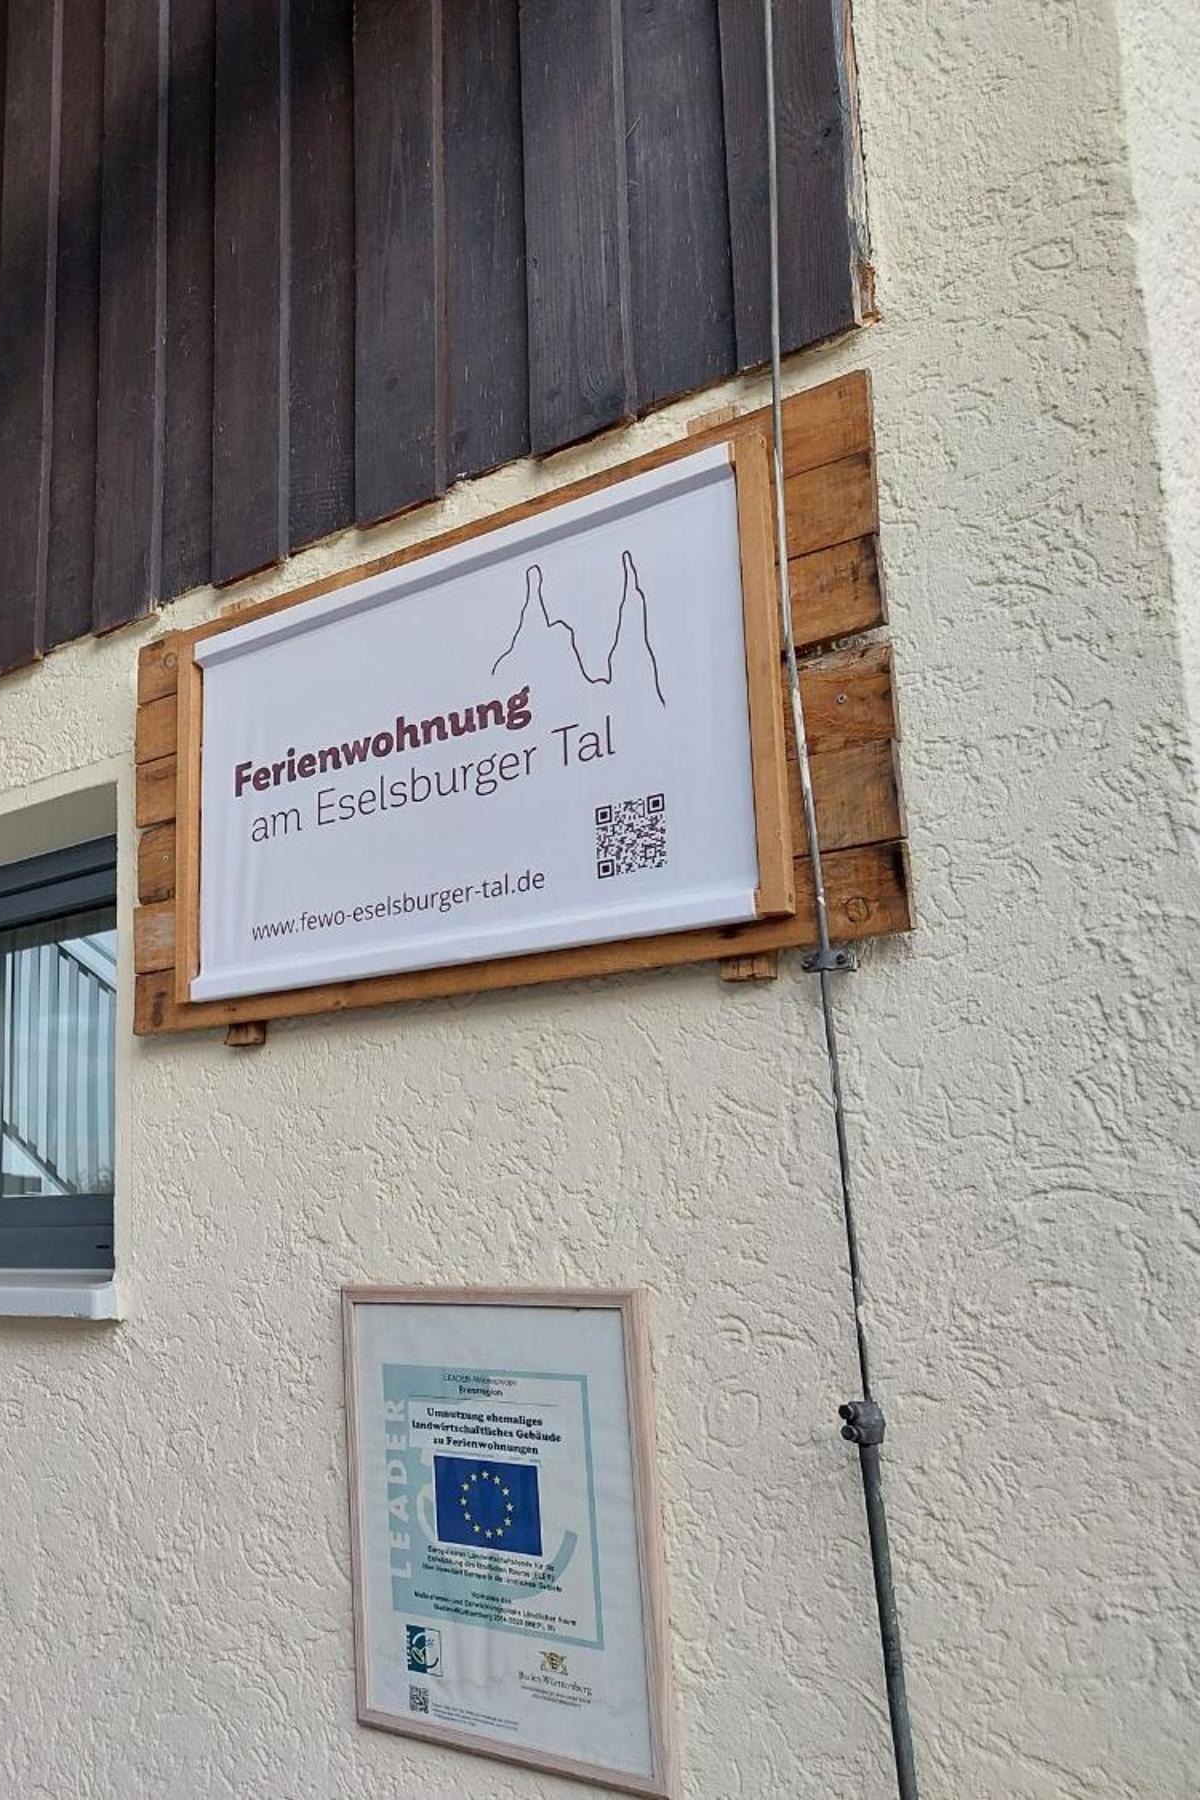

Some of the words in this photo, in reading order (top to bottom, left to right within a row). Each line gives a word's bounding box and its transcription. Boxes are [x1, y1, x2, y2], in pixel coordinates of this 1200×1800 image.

[235, 685, 532, 797] Ferienwohnung
[252, 808, 302, 842] am
[317, 747, 537, 825] Eselsburger
[551, 715, 616, 766] Tal
[252, 870, 545, 941] www.fewo-eselsburger-tal.de
[411, 1419, 514, 1439] landwirtschaftliches
[516, 1428, 562, 1443] Gebäude
[426, 1407, 484, 1424] Umnutzung
[486, 1411, 543, 1427] ehemaliges
[446, 1436, 539, 1455] Ferienwohnungen
